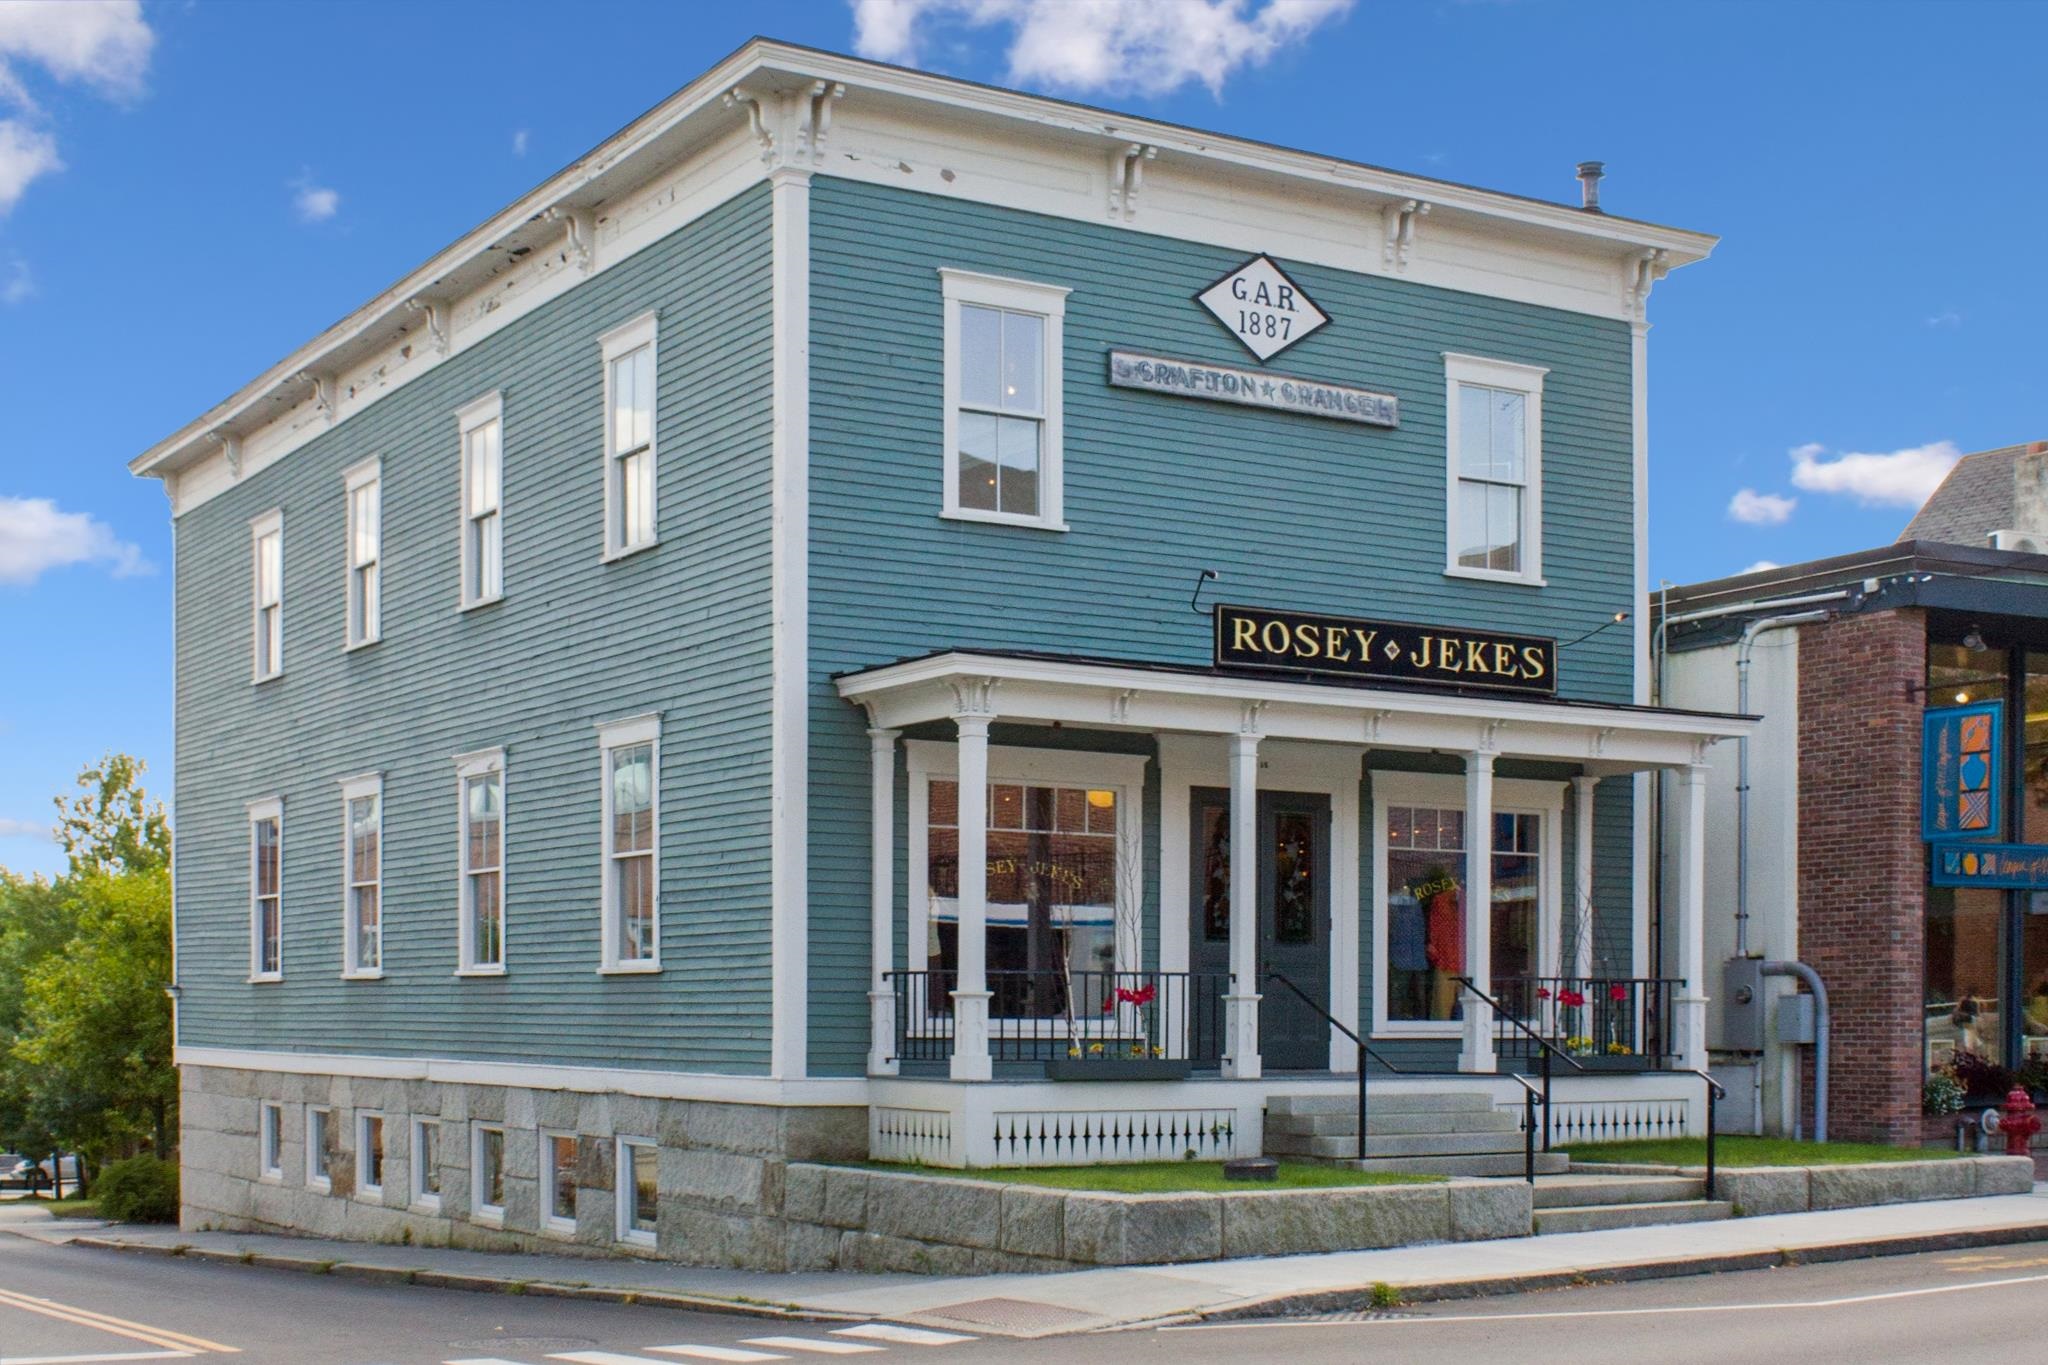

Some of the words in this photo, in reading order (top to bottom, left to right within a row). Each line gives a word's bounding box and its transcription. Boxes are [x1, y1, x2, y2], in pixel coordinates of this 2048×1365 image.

[1239, 310, 1292, 341] 1887
[1136, 360, 1257, 398] GRAFTON
[1231, 616, 1377, 663] ROSEY
[1410, 635, 1546, 680] JEKES
[985, 858, 1017, 877] SEY
